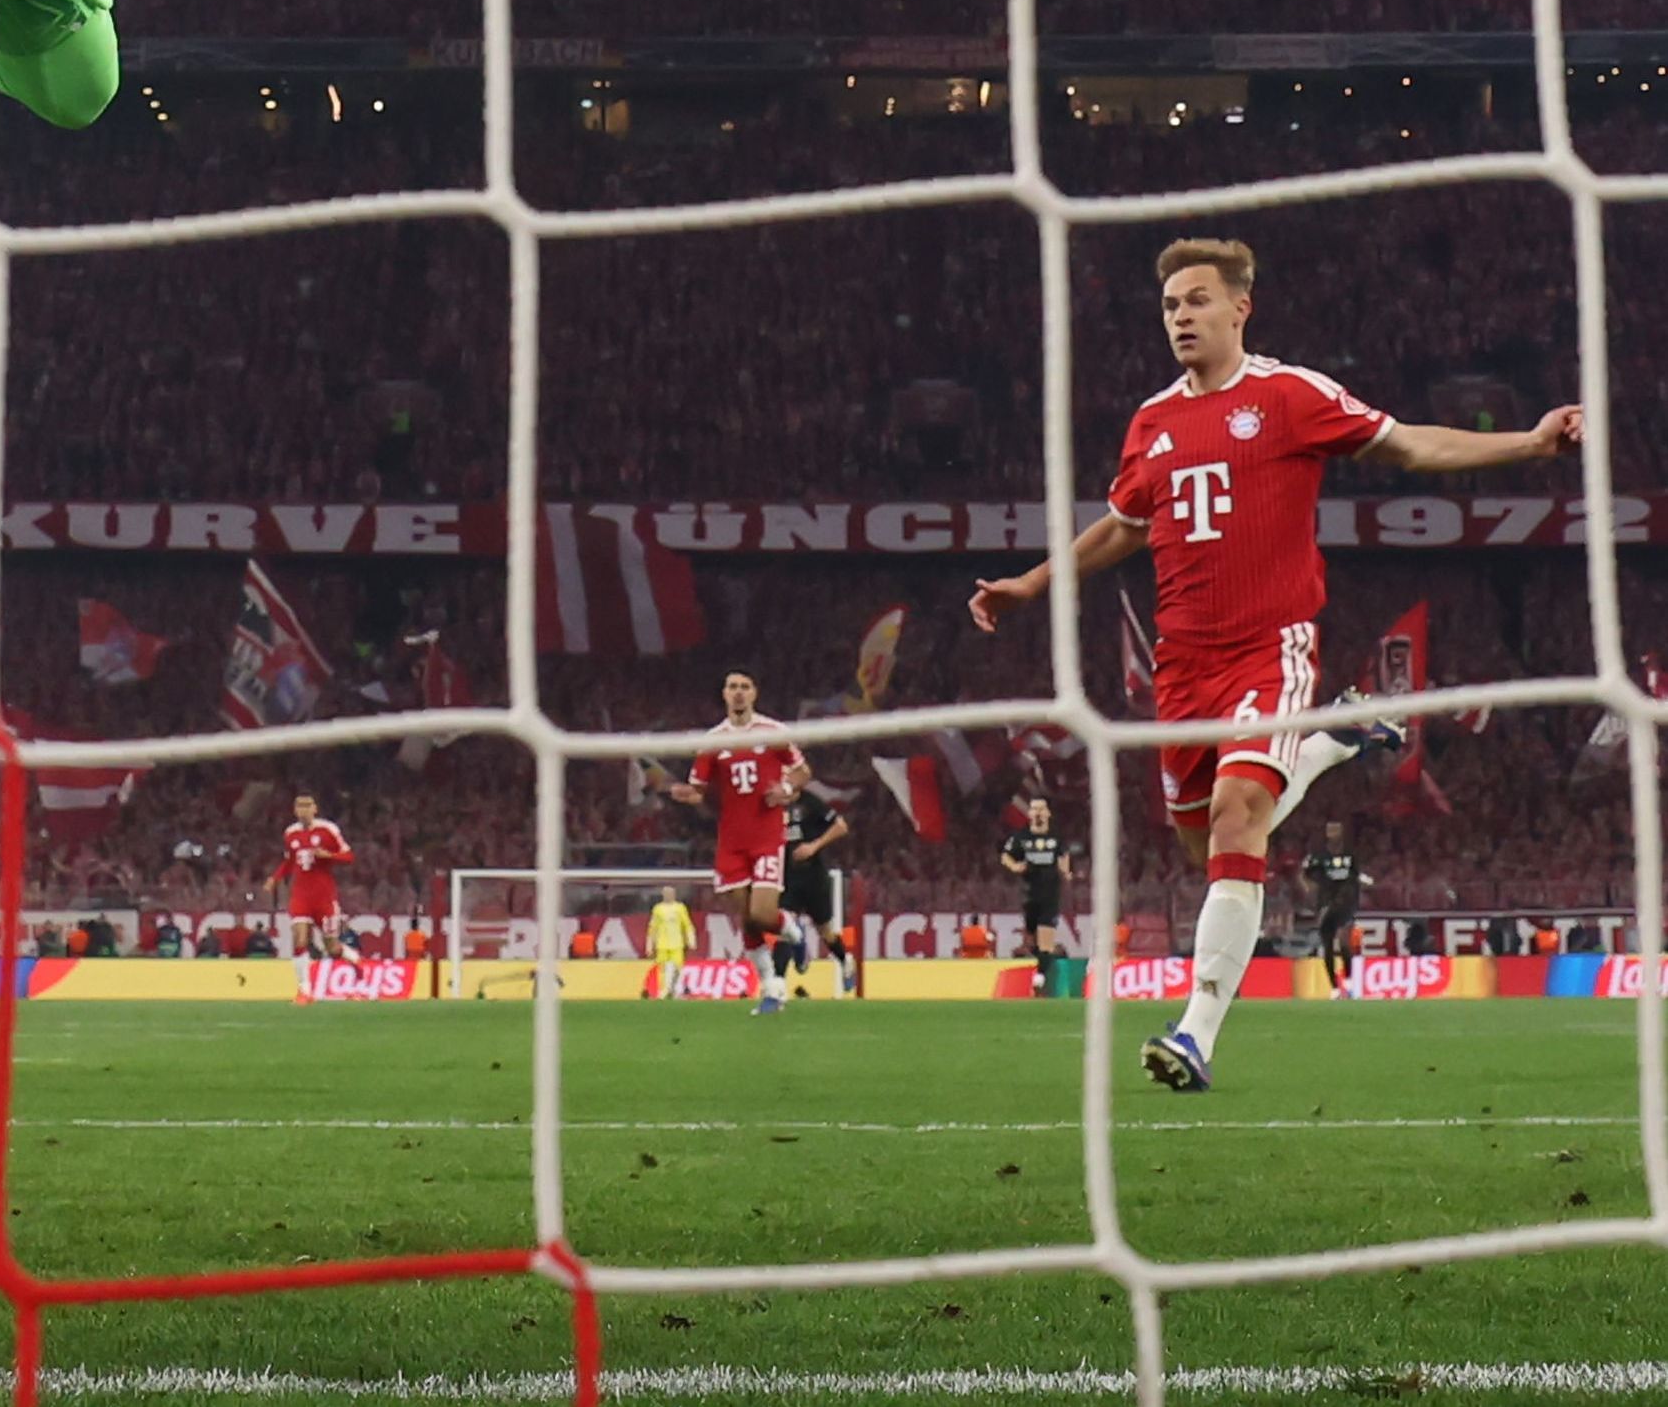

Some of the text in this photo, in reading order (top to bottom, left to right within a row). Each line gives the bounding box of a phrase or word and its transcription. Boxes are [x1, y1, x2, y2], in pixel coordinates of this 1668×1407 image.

[652, 501, 1108, 552] ÜNCH
[1316, 496, 1652, 546] 1972
[1171, 462, 1232, 543] T
[1232, 689, 1262, 741] 6
[753, 854, 779, 881] 45
